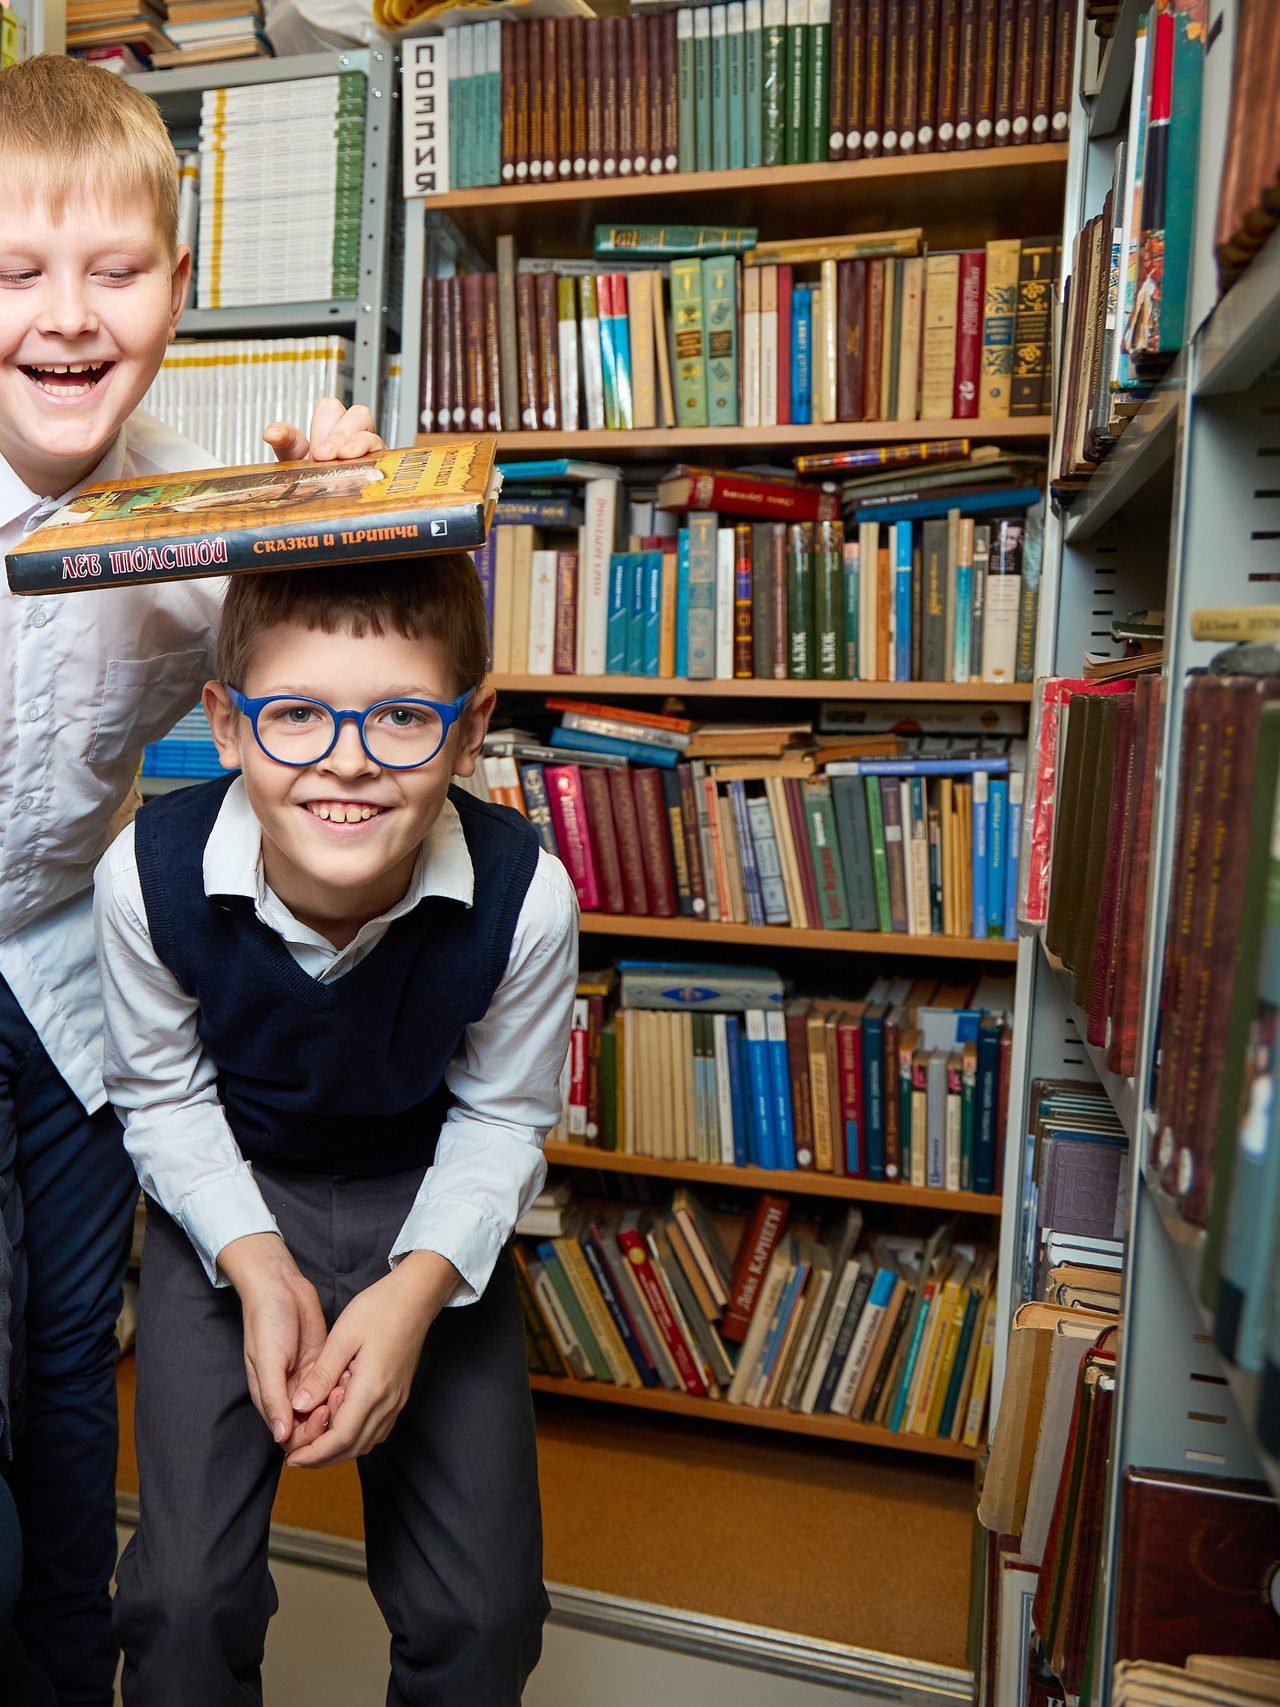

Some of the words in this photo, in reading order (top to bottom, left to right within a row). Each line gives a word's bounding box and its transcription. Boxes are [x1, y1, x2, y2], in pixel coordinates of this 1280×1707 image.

[415, 44, 436, 192] ПОЭЗИЯ
[61, 556, 102, 580] ЛЕВ
[110, 537, 229, 574] ТОЛСТОЙ
[252, 533, 319, 554] СКАЗКИ
[322, 531, 335, 547] И
[340, 523, 419, 546] ПРИТЧИ
